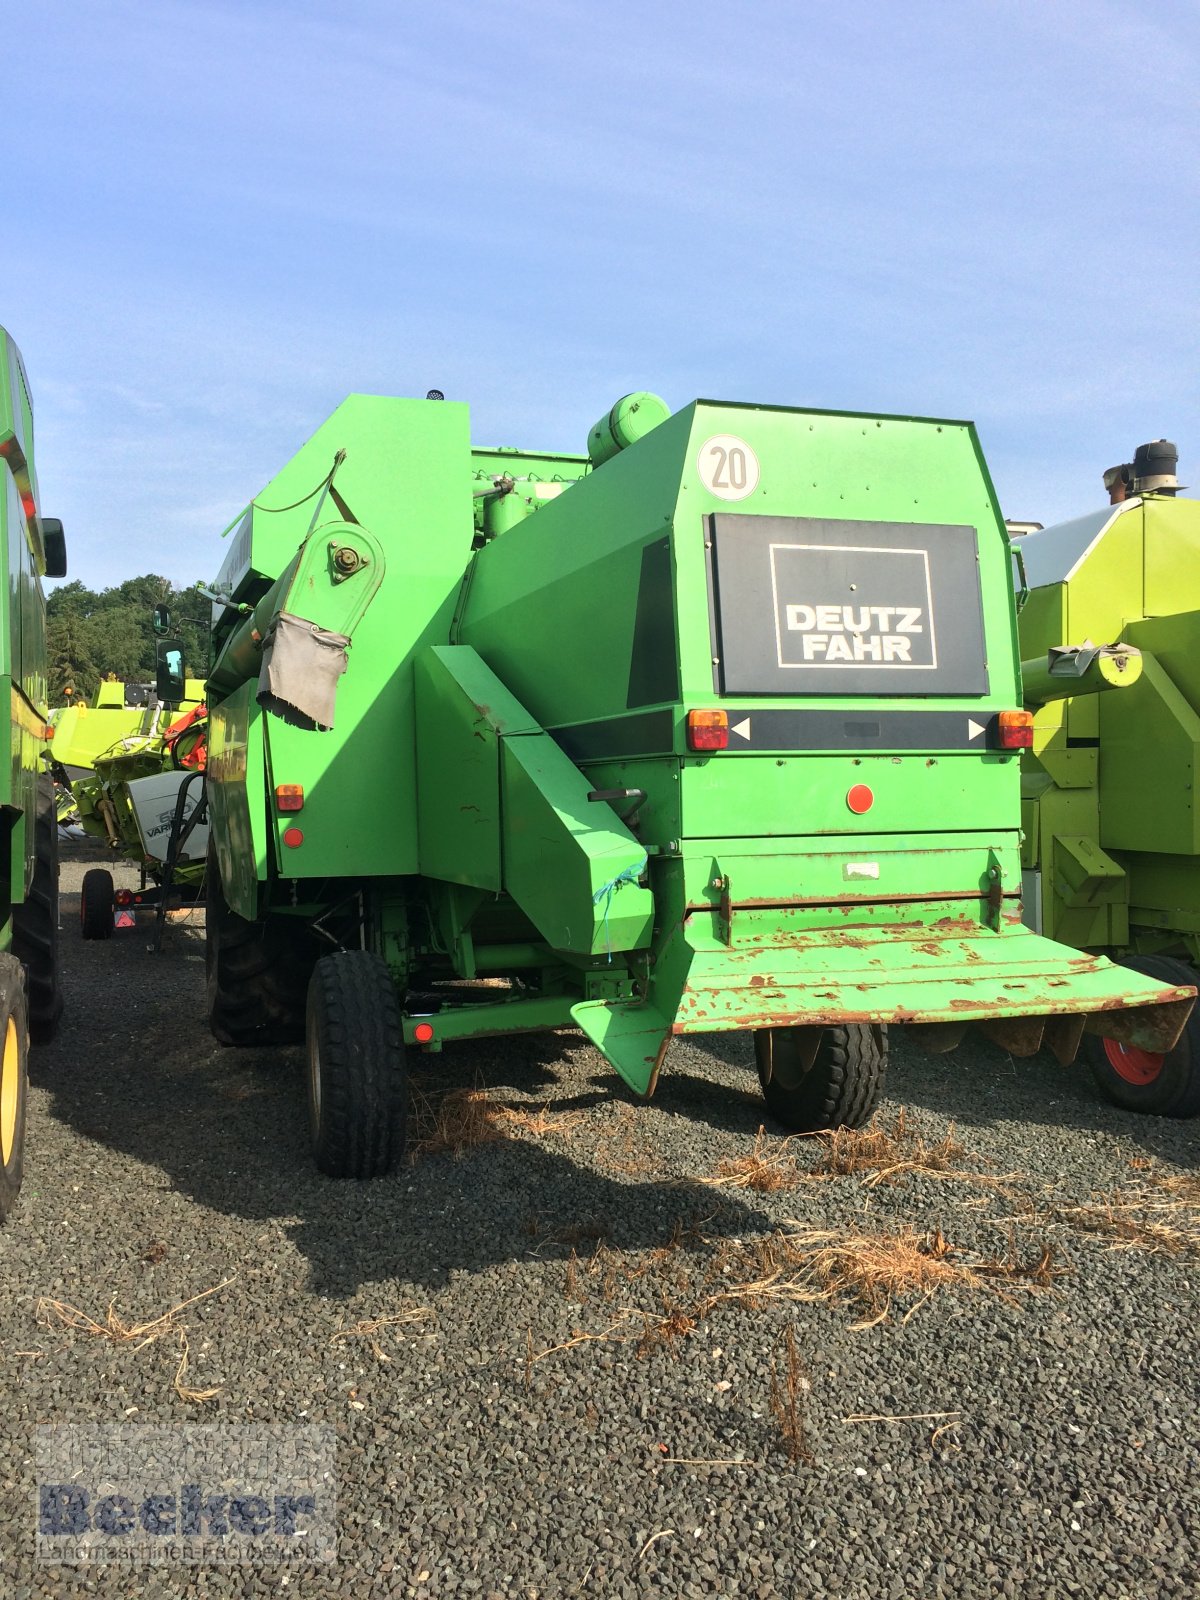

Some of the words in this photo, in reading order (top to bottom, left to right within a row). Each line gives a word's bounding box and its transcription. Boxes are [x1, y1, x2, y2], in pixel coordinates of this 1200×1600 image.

[710, 446, 747, 489] 20
[785, 604, 923, 633] DEUTZ
[802, 634, 912, 662] FAHR
